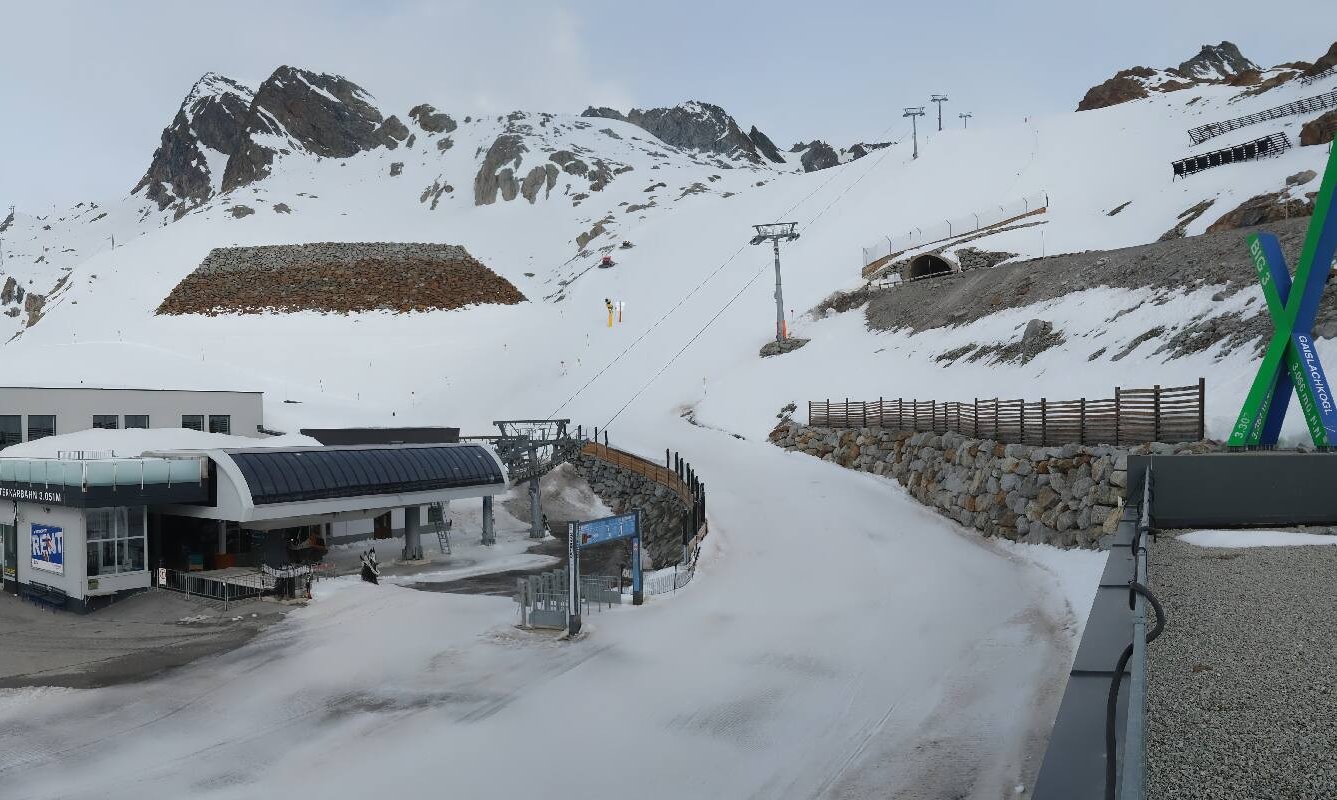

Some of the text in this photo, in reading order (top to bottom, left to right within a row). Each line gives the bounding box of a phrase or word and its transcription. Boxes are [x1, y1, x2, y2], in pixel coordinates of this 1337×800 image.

[1250, 239, 1271, 286] BIG 3
[1299, 335, 1333, 416] GAISLACHKOGL
[31, 532, 62, 556] RENT
